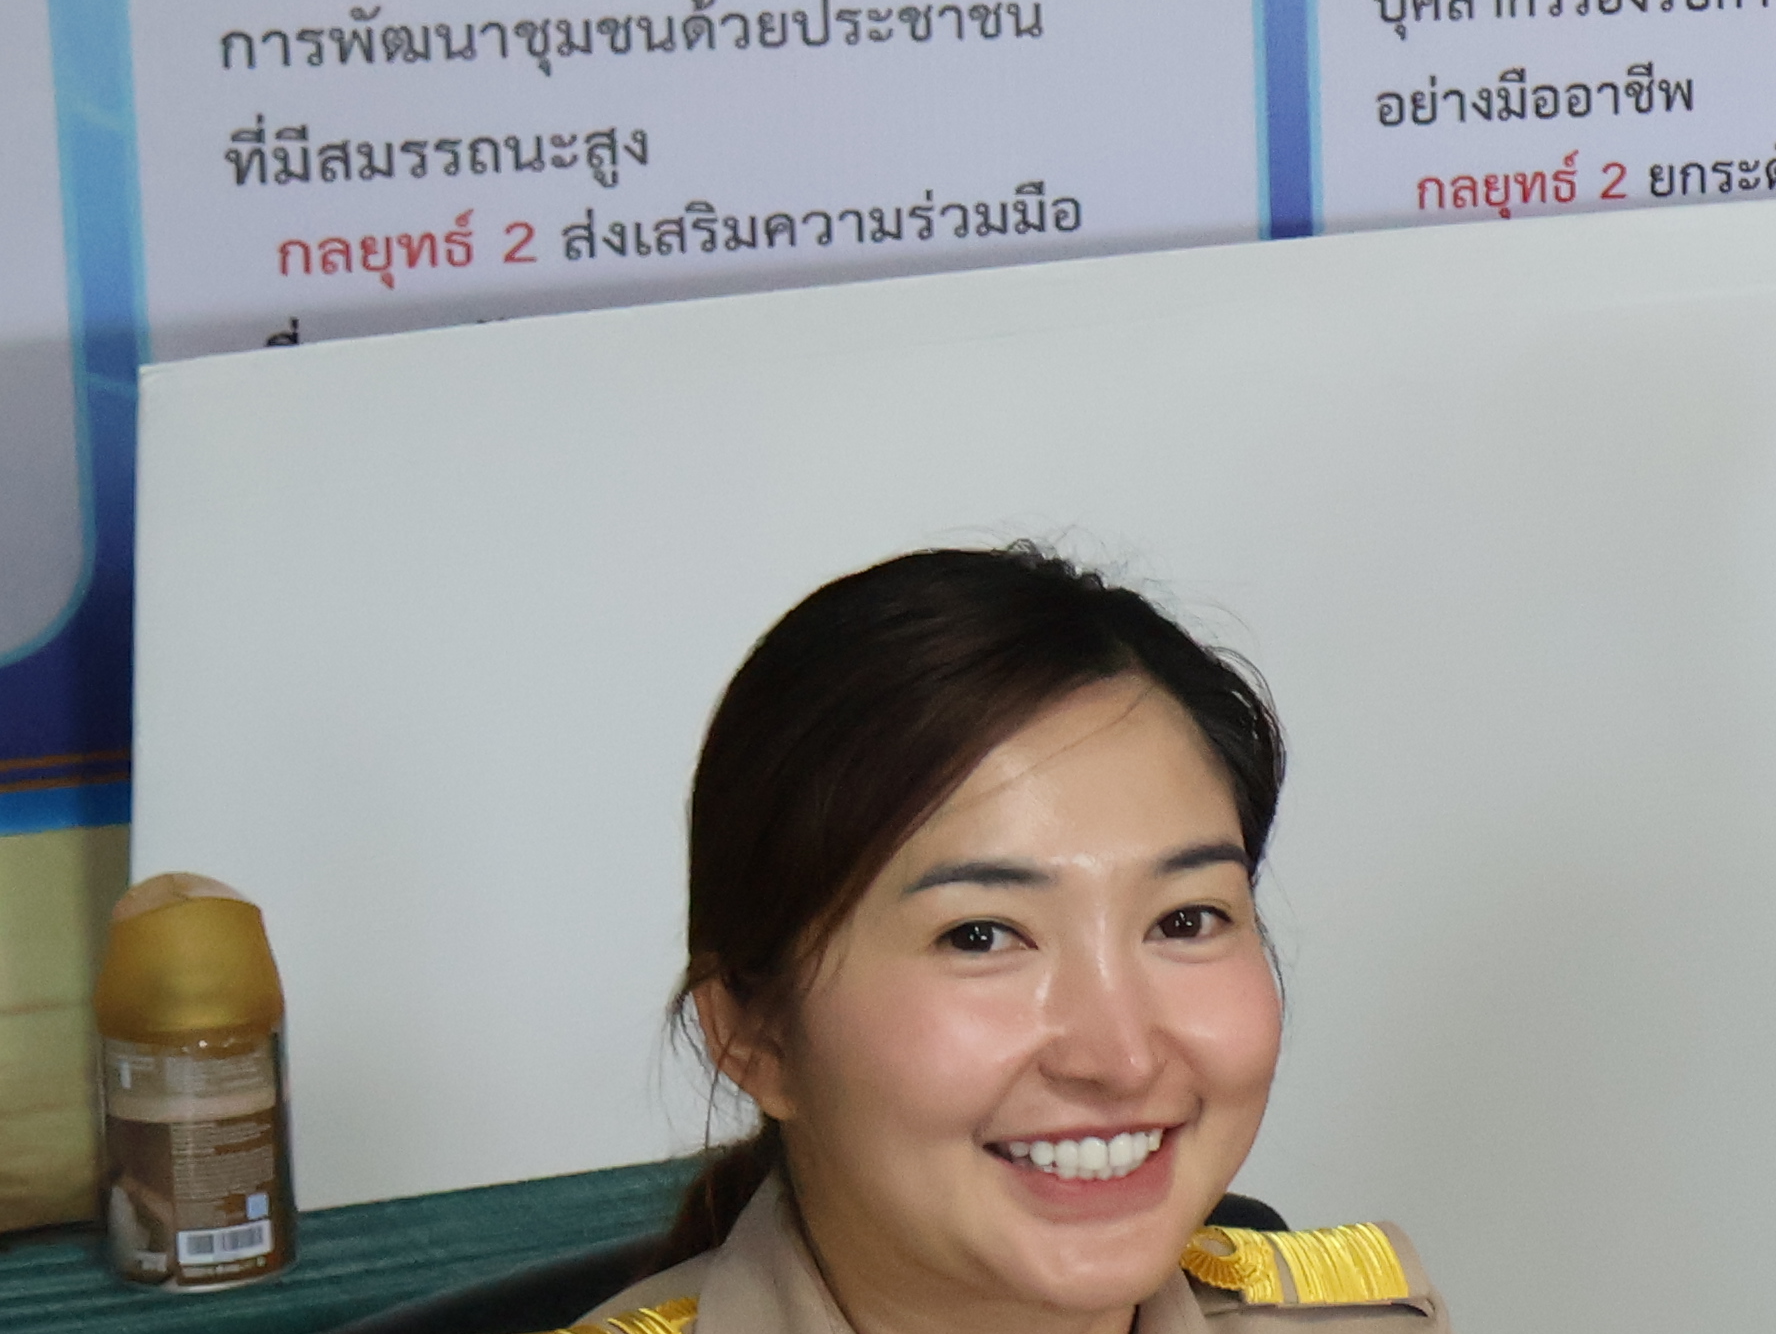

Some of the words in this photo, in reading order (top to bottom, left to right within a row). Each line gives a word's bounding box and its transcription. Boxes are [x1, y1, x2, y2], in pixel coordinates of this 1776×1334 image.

[1376, 61, 1693, 127] อย่างมืออาชีพ
[224, 113, 648, 188] ที่มีสมรรถนะสูง
[1417, 150, 1578, 217] กลยุทธ์
[1600, 162, 1627, 201] 2
[278, 209, 473, 289] กลยุทธ์
[503, 221, 537, 263] 2
[562, 180, 1081, 261] ส่งเสริมความร่วมมือ
